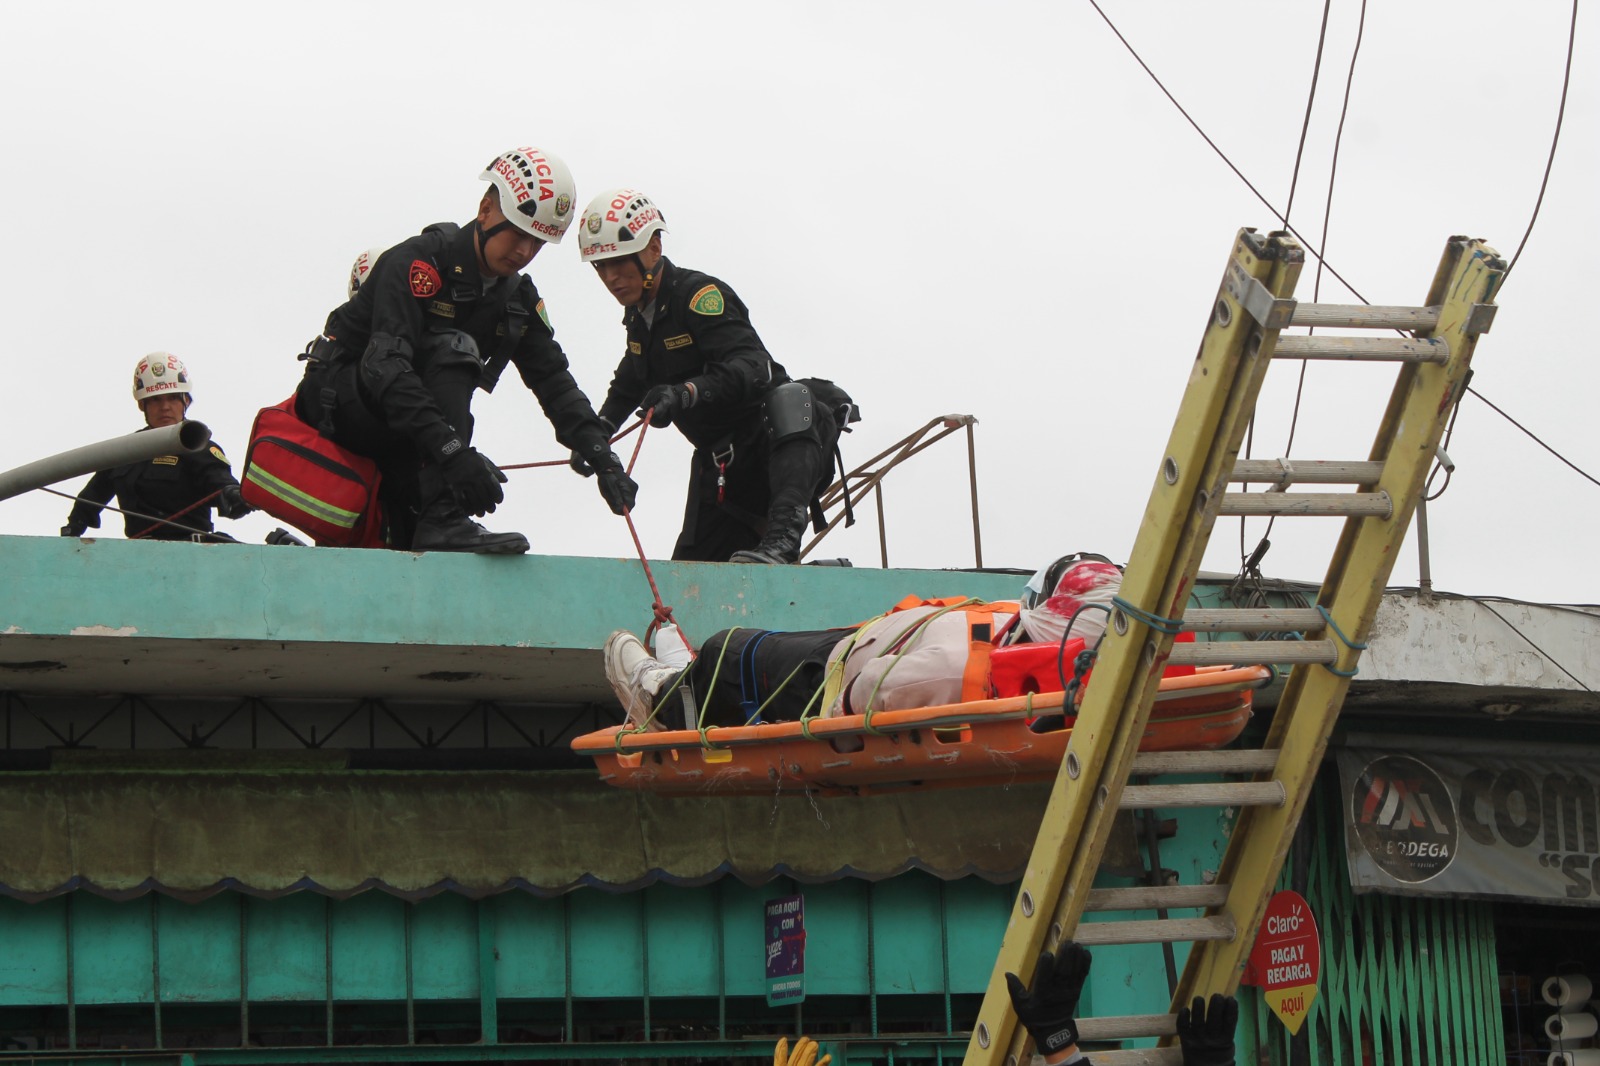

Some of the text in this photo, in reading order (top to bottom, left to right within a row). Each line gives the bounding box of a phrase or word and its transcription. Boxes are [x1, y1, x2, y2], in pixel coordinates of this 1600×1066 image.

[493, 158, 530, 203] RESCATE
[517, 146, 554, 202] OLICIA
[146, 382, 177, 394] RESCATE
[767, 898, 800, 916] PAGA AQUÍ
[782, 918, 794, 930] CON
[1267, 911, 1301, 934] Claro
[1271, 944, 1305, 965] PAGA Y
[1267, 963, 1312, 984] RECARGA
[1280, 992, 1304, 1016] AQUÍ
[1048, 1031, 1071, 1050] PETZL
